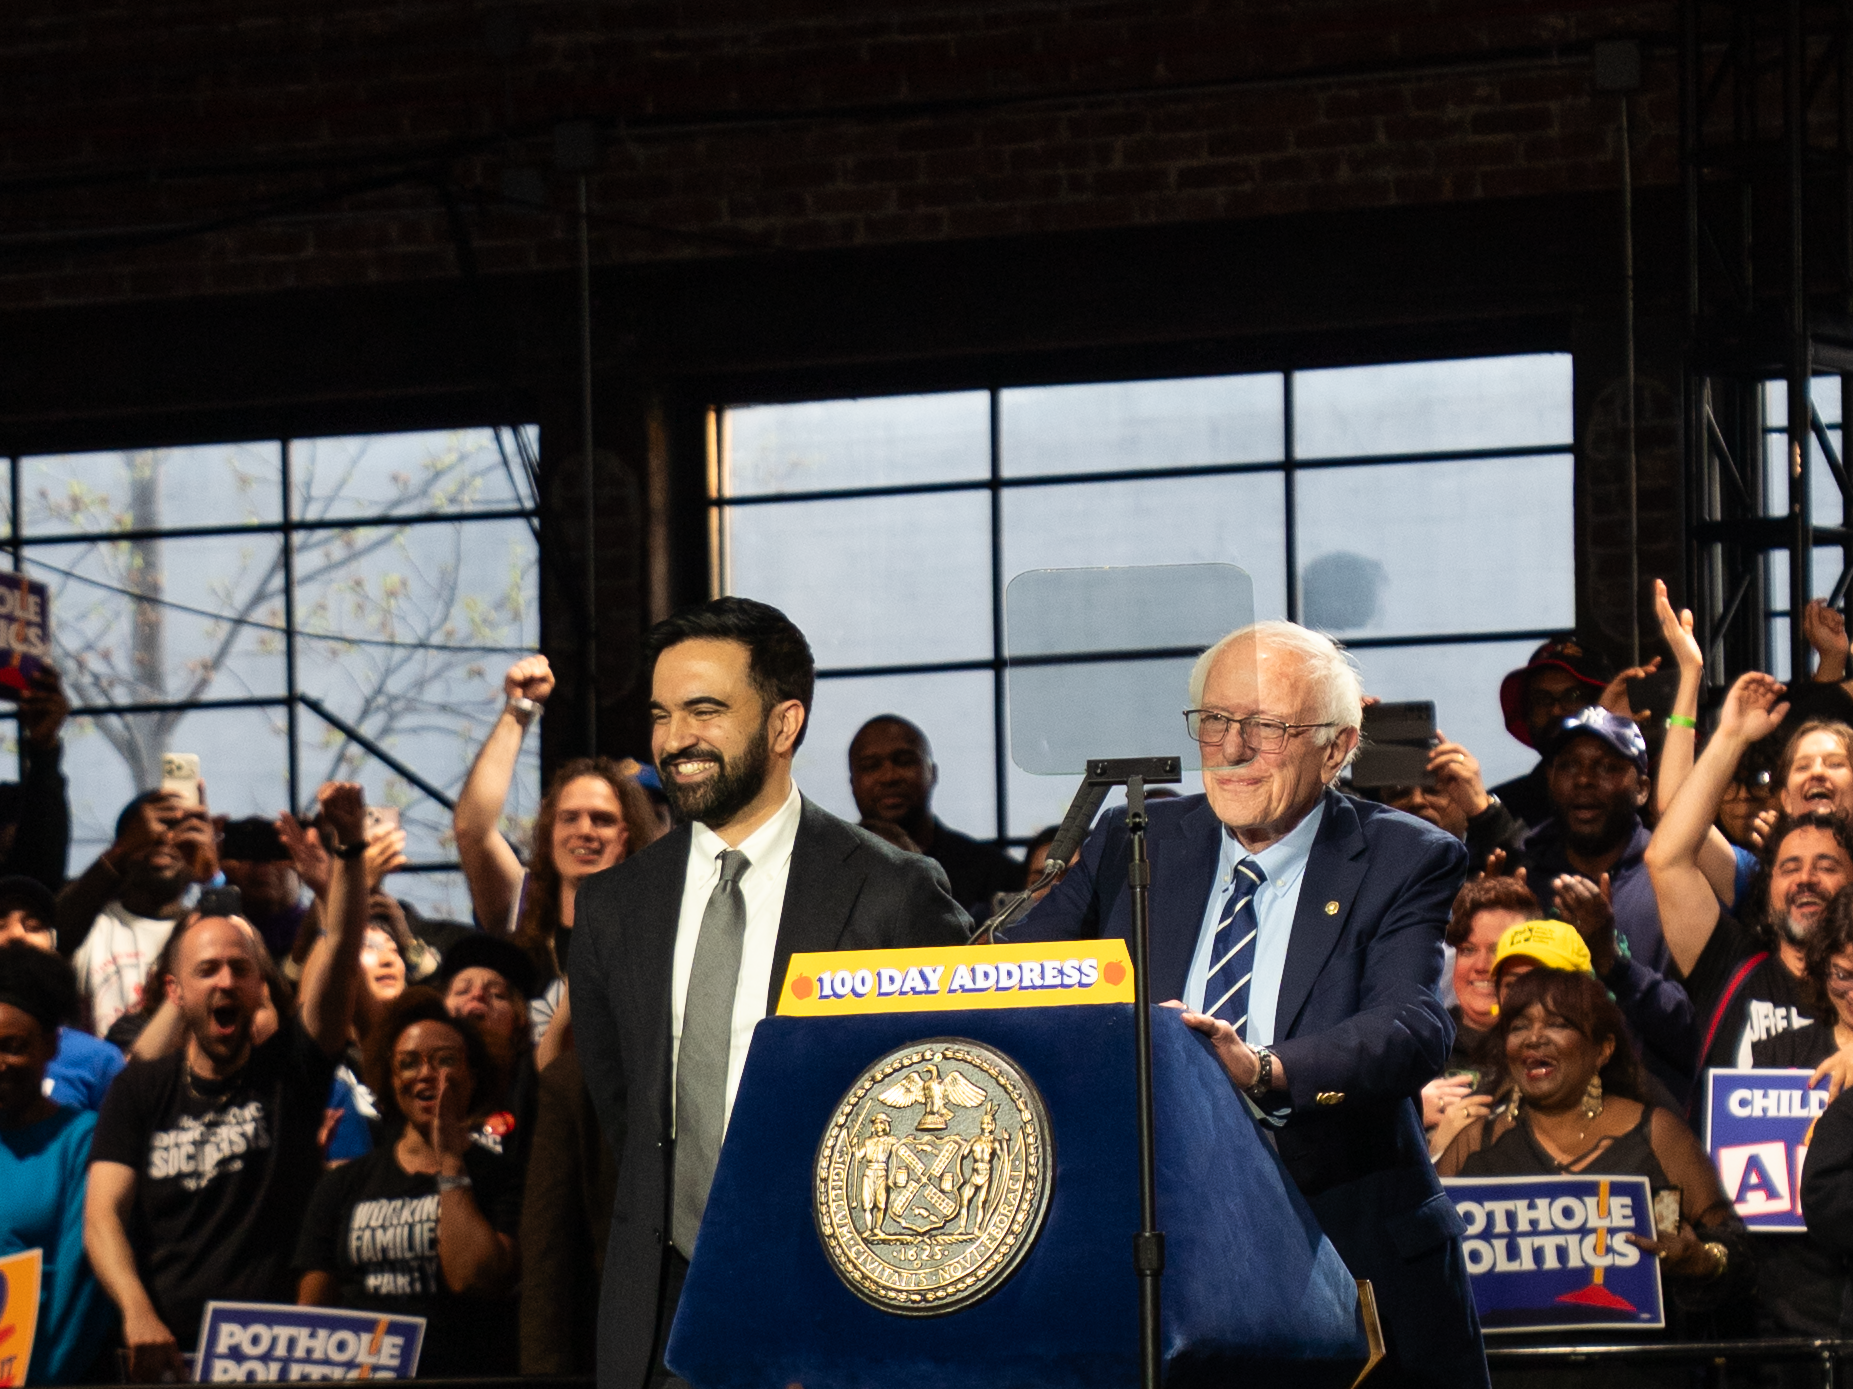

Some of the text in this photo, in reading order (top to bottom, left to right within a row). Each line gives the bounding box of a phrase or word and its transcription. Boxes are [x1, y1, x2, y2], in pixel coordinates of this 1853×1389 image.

[0, 587, 41, 622] OLE
[0, 620, 46, 656] ICS
[818, 958, 1099, 1000] 100 DAY ADDRESS
[1729, 1088, 1829, 1118] CHILD
[1734, 1153, 1785, 1206] A
[351, 1194, 442, 1230] WORKIN
[850, 1245, 928, 1287] CIVITATIS
[938, 1248, 982, 1283] NOVI
[982, 1171, 1023, 1249] EBORACI
[1455, 1196, 1636, 1236] OTHOLE
[350, 1221, 438, 1264] FAMILIE
[900, 1246, 944, 1261] 1625
[1462, 1232, 1641, 1275] OLITICS
[214, 1322, 405, 1366] POTHOLE
